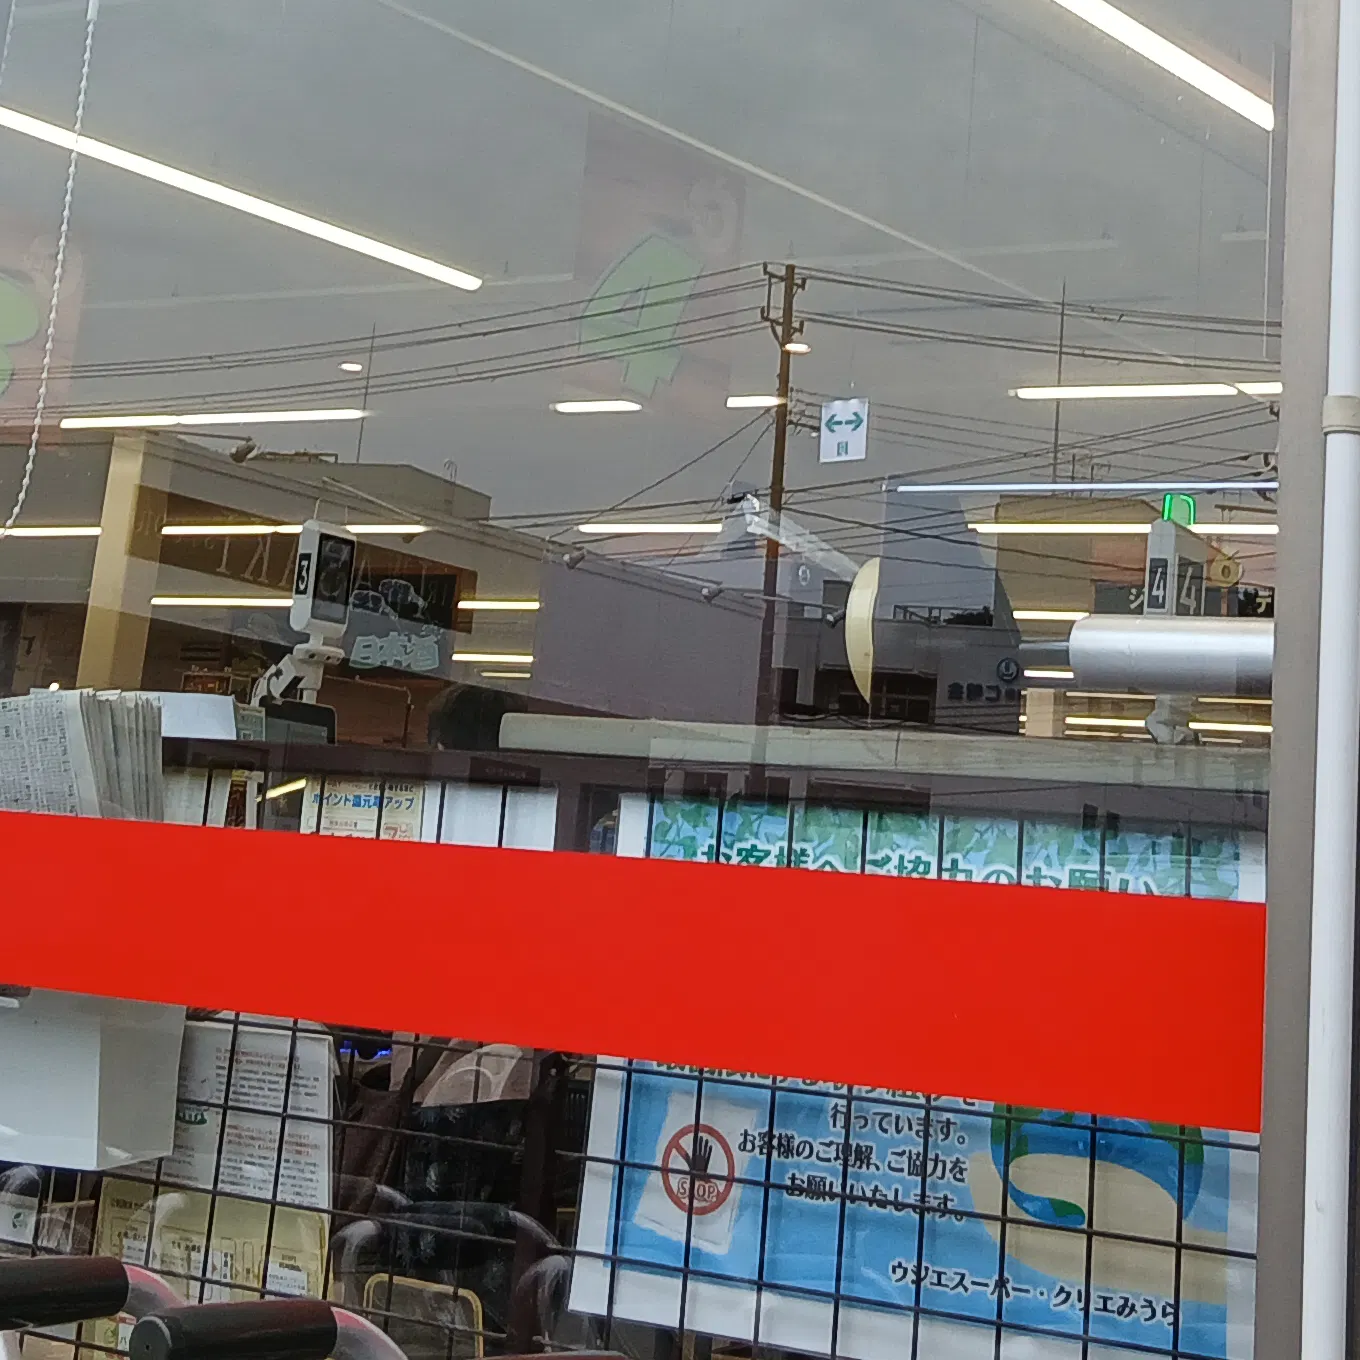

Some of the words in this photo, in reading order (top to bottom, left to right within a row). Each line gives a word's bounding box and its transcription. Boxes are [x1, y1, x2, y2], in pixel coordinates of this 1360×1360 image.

[1151, 567, 1165, 605] 4
[349, 630, 440, 672] 日本酒
[829, 1101, 966, 1146] 行っています。
[738, 1128, 969, 1183] お客様のご理解、ご協力を
